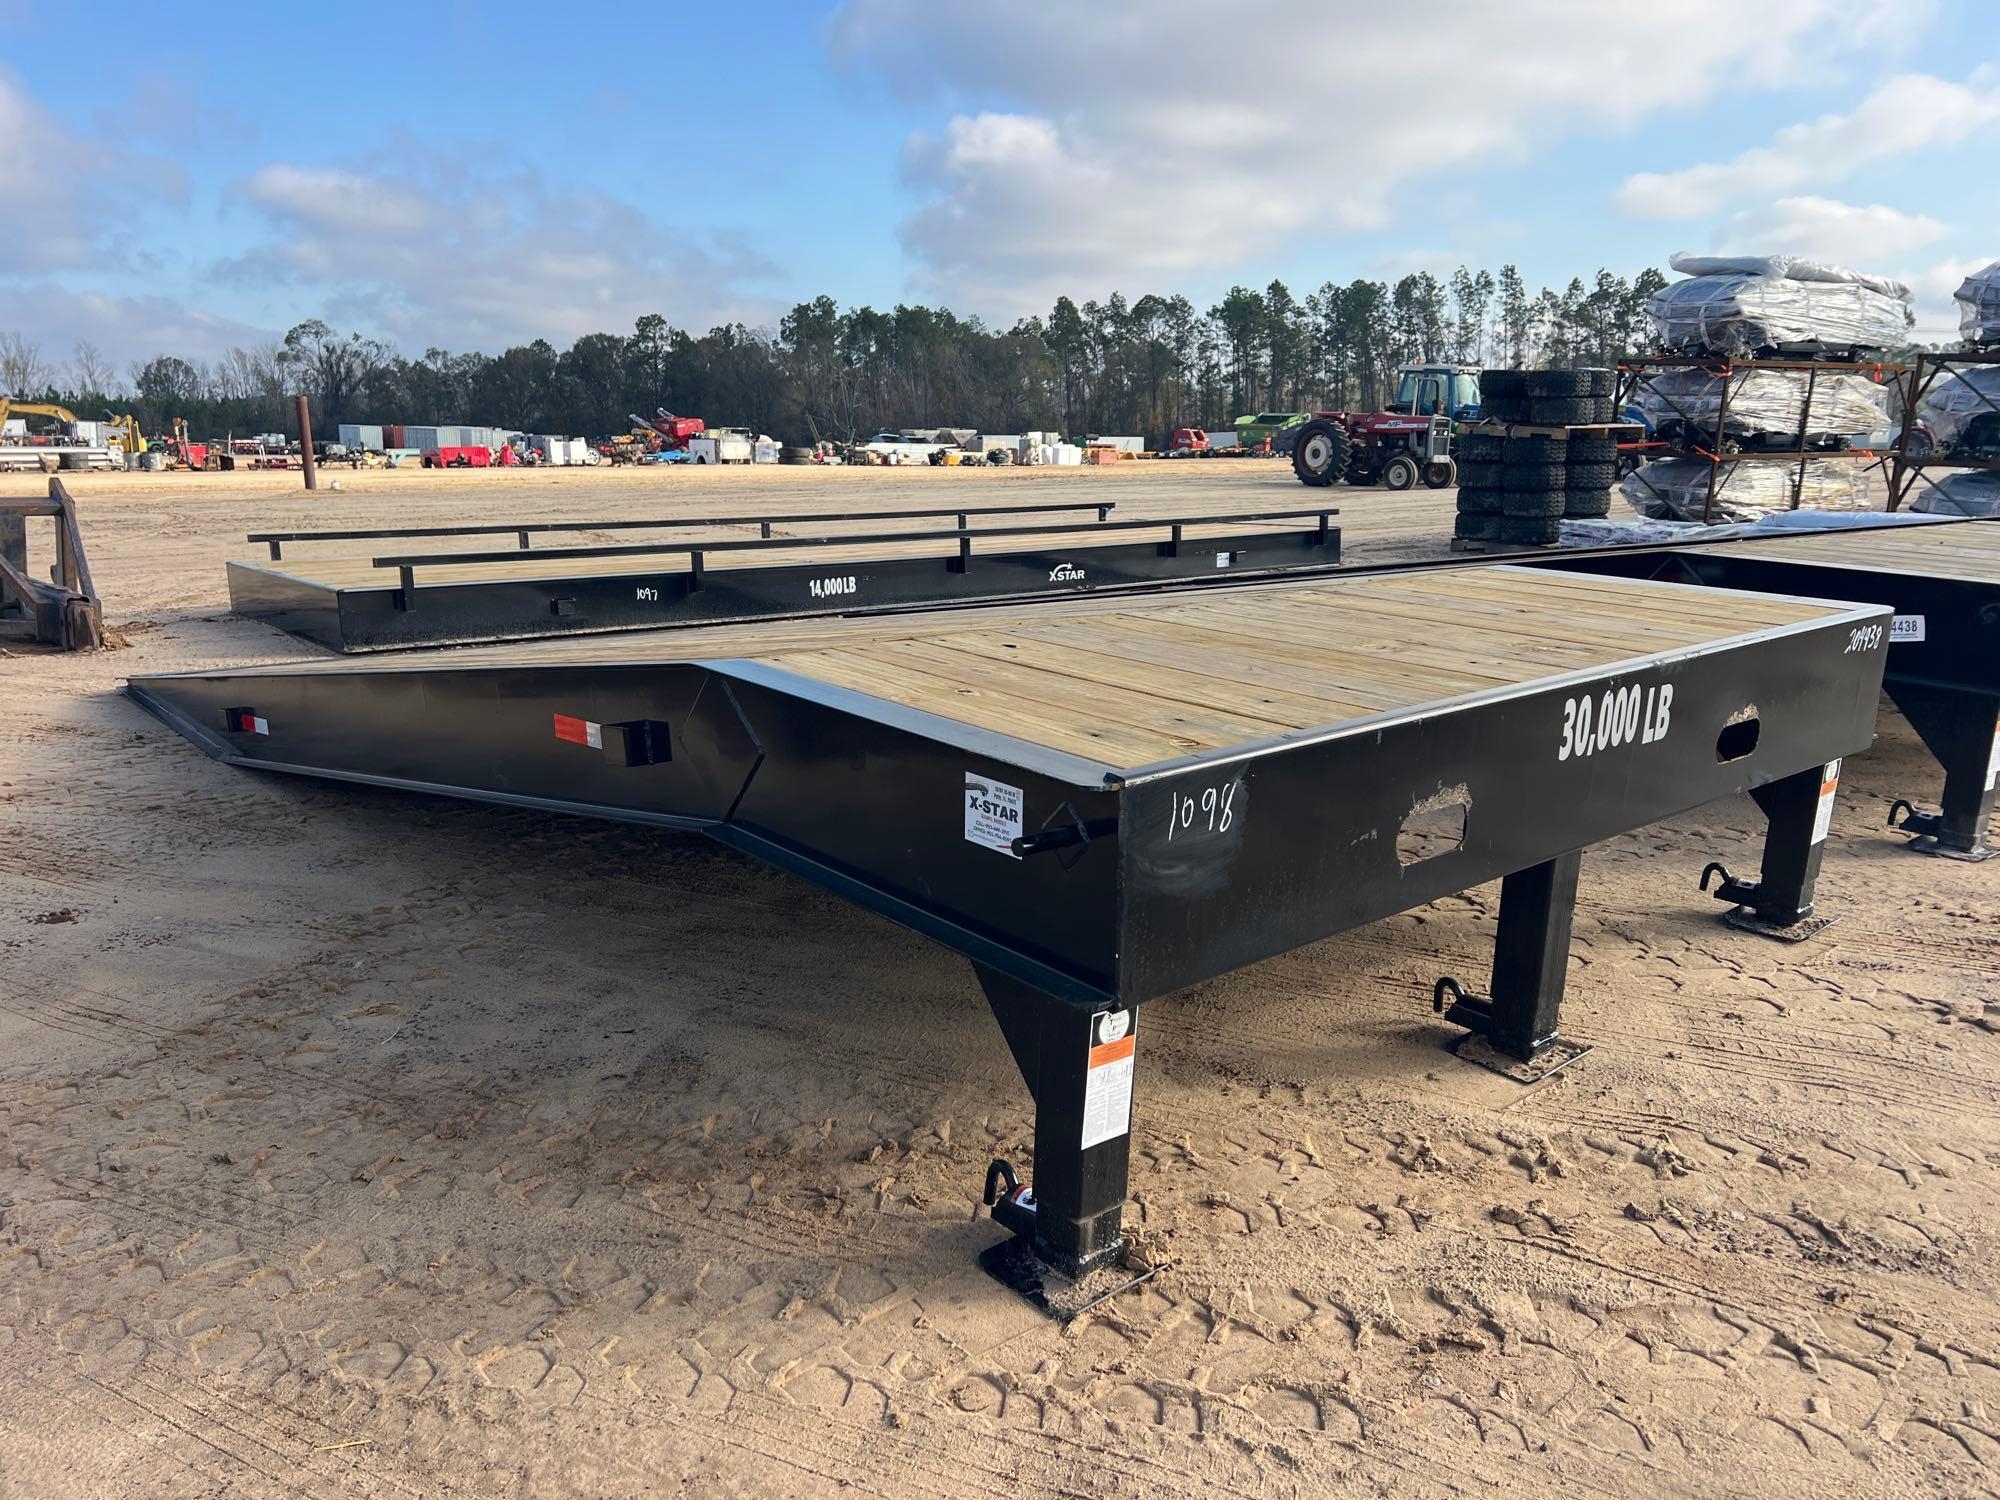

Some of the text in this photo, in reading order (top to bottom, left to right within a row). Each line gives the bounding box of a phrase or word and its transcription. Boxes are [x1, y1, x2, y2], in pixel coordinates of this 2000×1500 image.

[1048, 568, 1085, 581] XSTAR
[636, 587, 658, 601] 1097
[1558, 683, 1674, 761] 30,000 LB
[969, 794, 1019, 824] X-STAR
[1168, 782, 1237, 843] 1098
